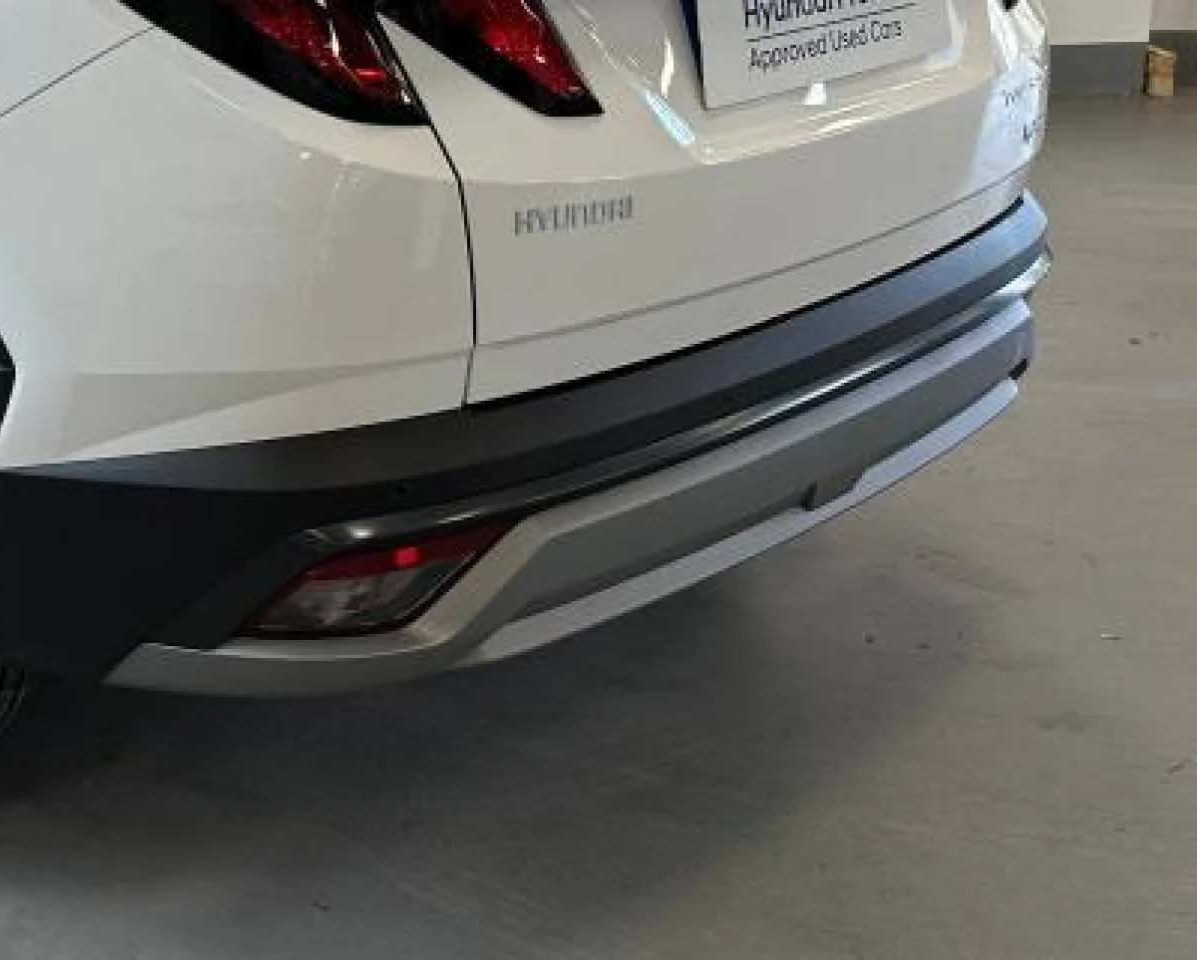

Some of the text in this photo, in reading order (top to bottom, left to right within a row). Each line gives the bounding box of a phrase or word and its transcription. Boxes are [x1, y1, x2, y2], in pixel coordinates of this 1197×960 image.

[749, 20, 903, 72] Approved Used Cars
[514, 195, 633, 237] HYUNDAI
